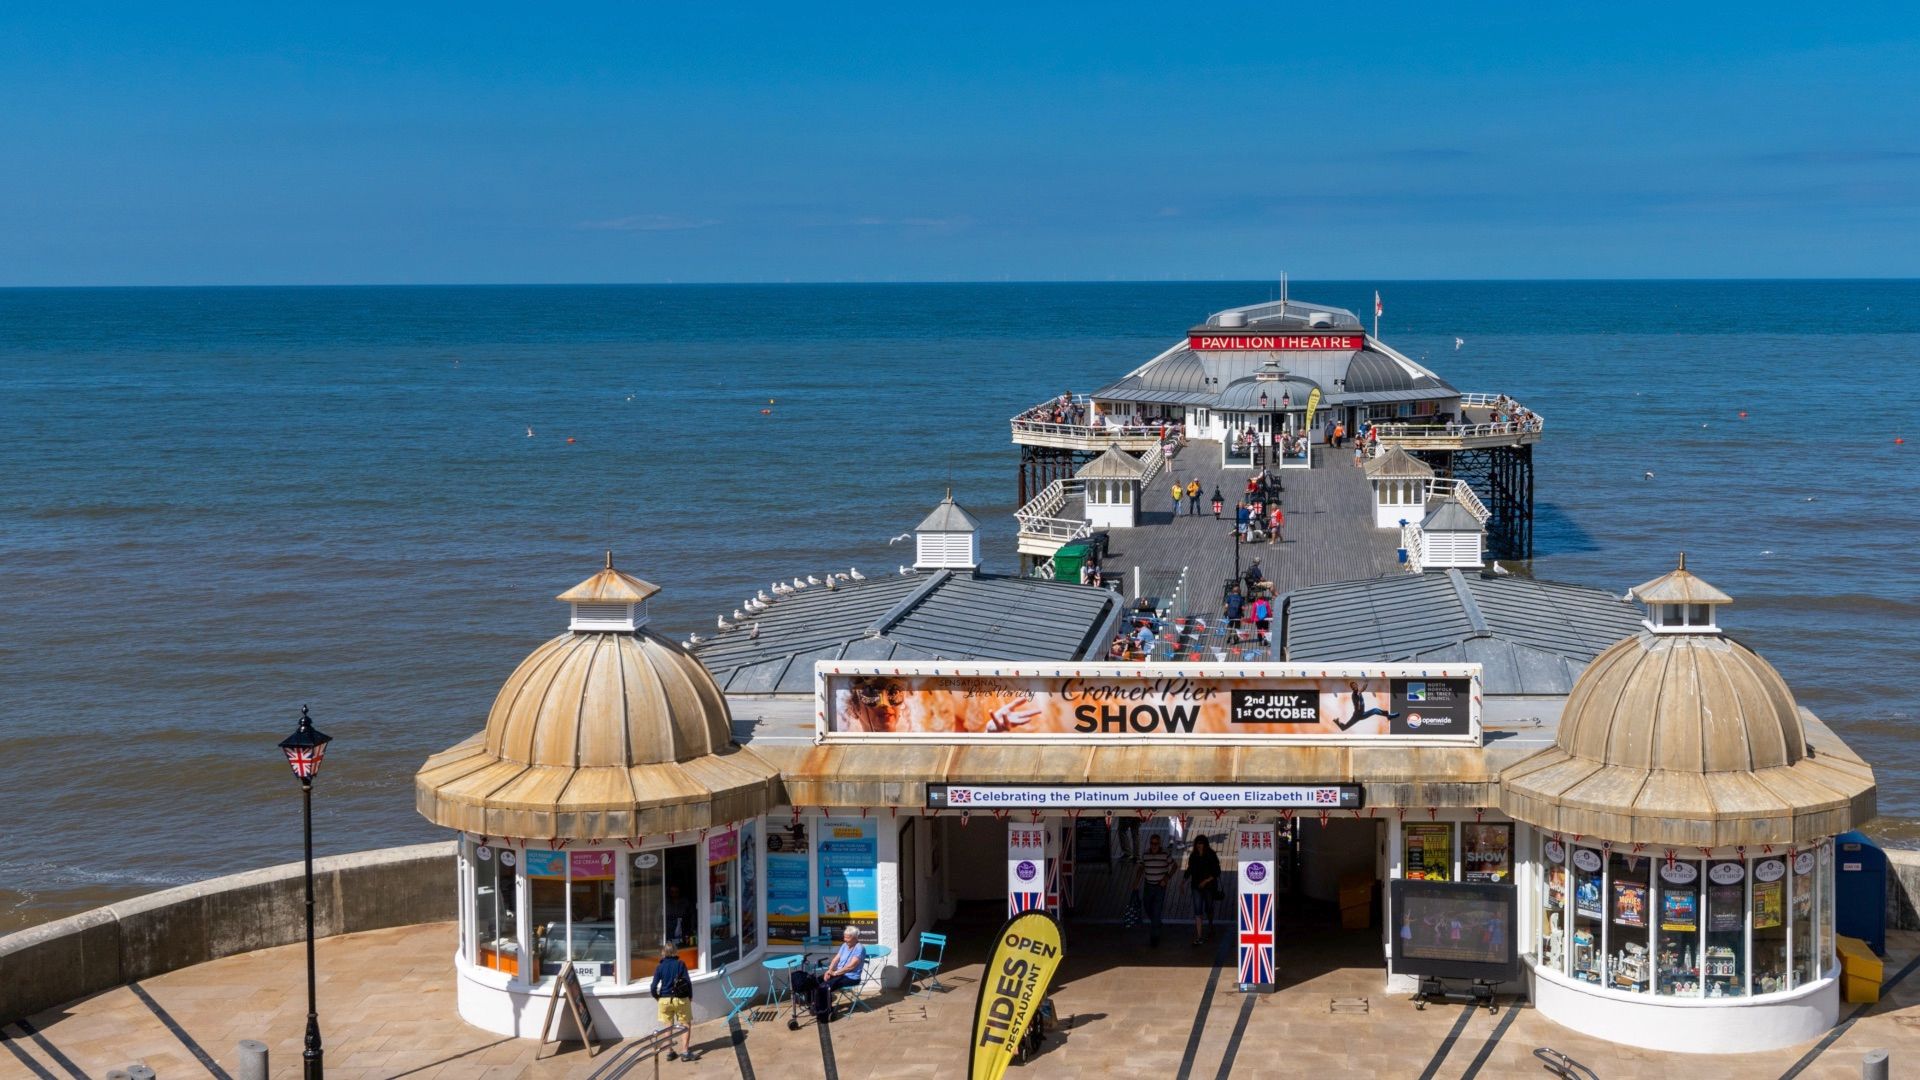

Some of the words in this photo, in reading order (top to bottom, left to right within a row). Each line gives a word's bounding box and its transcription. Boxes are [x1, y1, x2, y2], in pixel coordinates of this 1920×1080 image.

[1202, 337, 1274, 349] PAVILION
[1279, 337, 1351, 348] THEATRE
[938, 679, 998, 687] SENSATIONAL
[994, 685, 1036, 702] Variety
[1061, 677, 1154, 702] Cromer
[1155, 677, 1218, 702] Pier
[1244, 695, 1265, 707] 2nd
[1267, 695, 1300, 707] JULY
[1074, 705, 1201, 733] SHOW
[1236, 708, 1252, 719] 1st
[1254, 708, 1317, 719] OCTOBER
[1421, 717, 1452, 725] openwide
[973, 792, 1046, 803] Celebrating
[1050, 792, 1070, 801] the
[1075, 792, 1130, 801] Platinum
[1133, 791, 1178, 801] Jubilee
[1183, 791, 1196, 801] of
[1200, 791, 1240, 802] Queen
[1244, 791, 1303, 801] Elizabeth
[1307, 792, 1314, 801] II
[1467, 852, 1506, 862] SHOW
[1005, 933, 1058, 959] OPEN
[979, 957, 1028, 1047] TIDES
[1005, 963, 1041, 1052] RESTAURANT
